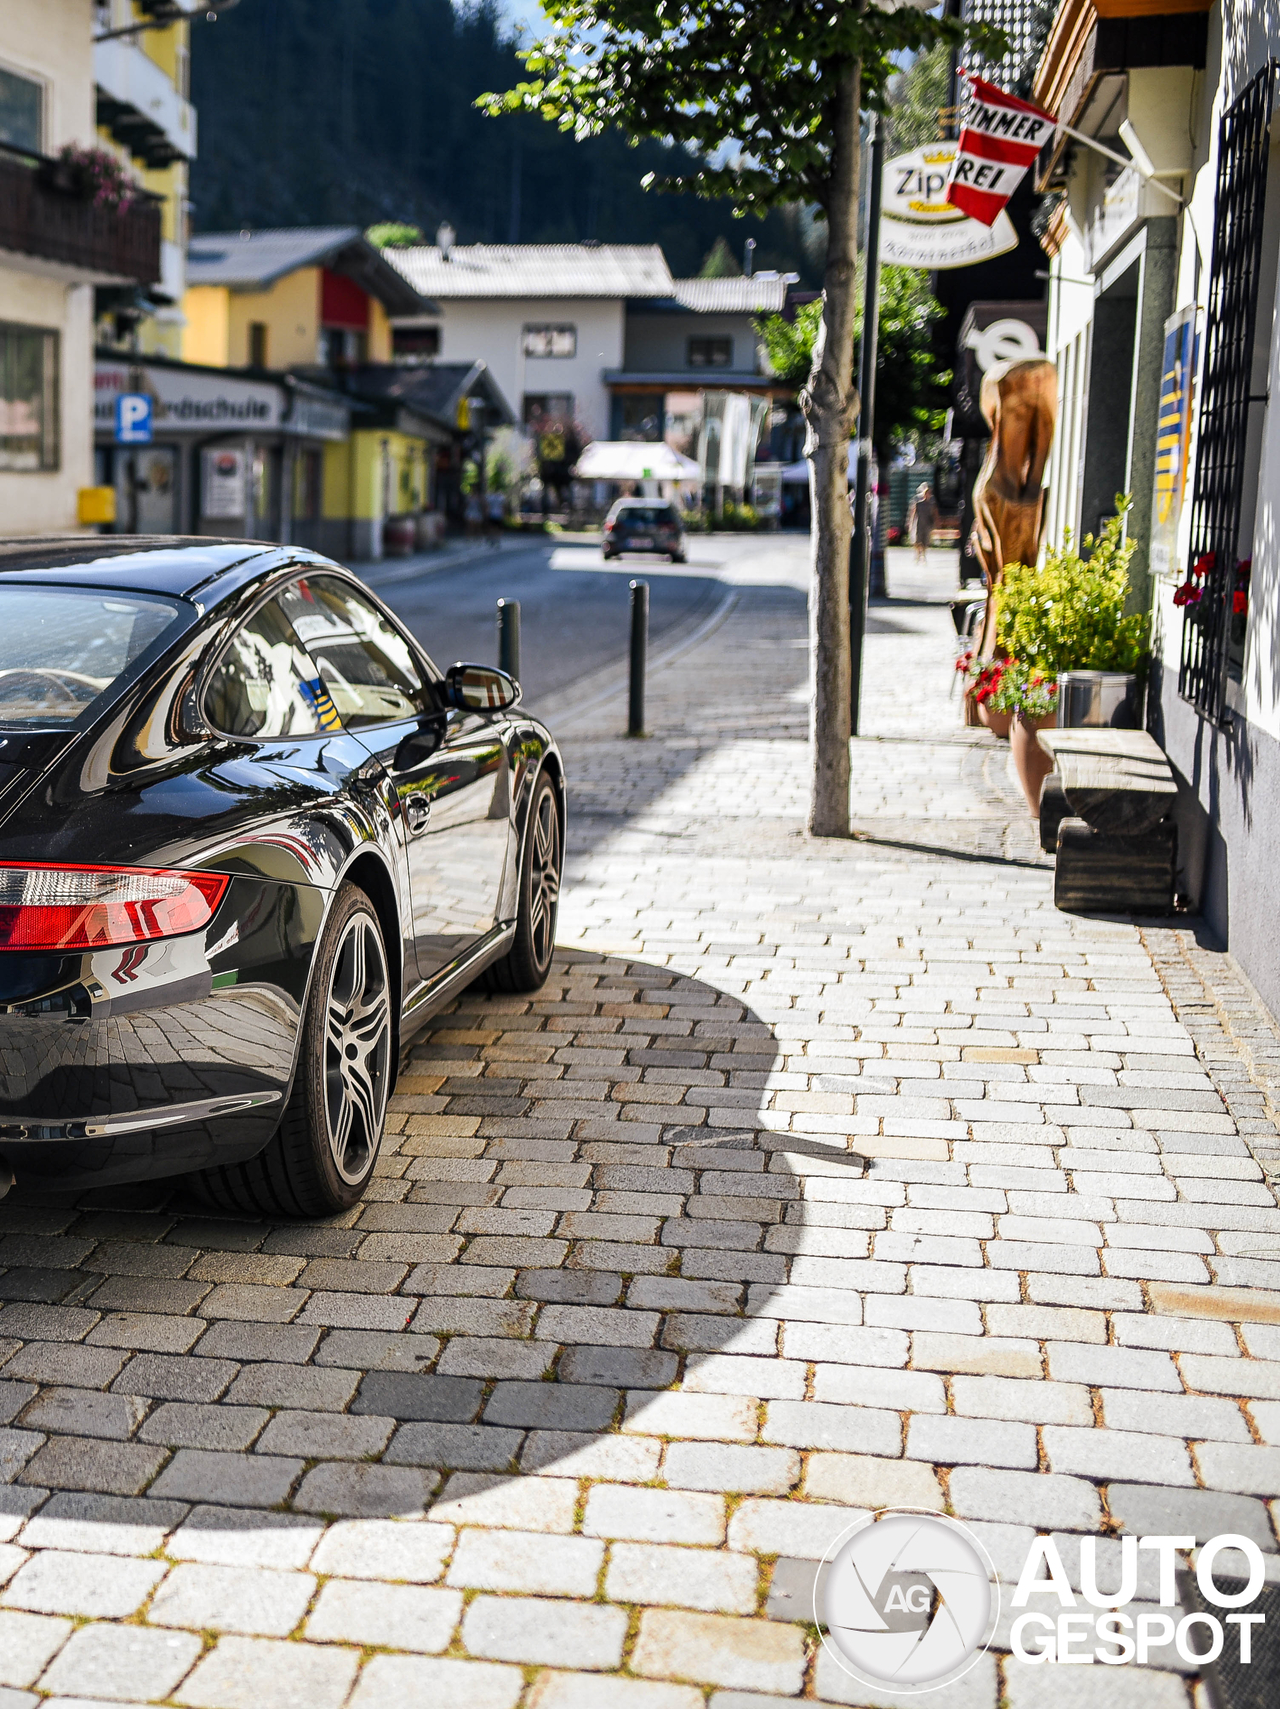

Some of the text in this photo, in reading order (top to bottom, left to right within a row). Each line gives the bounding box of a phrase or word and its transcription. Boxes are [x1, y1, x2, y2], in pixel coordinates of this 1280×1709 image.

[896, 168, 950, 201] Zip
[955, 158, 1004, 189] REI
[121, 396, 149, 430] P
